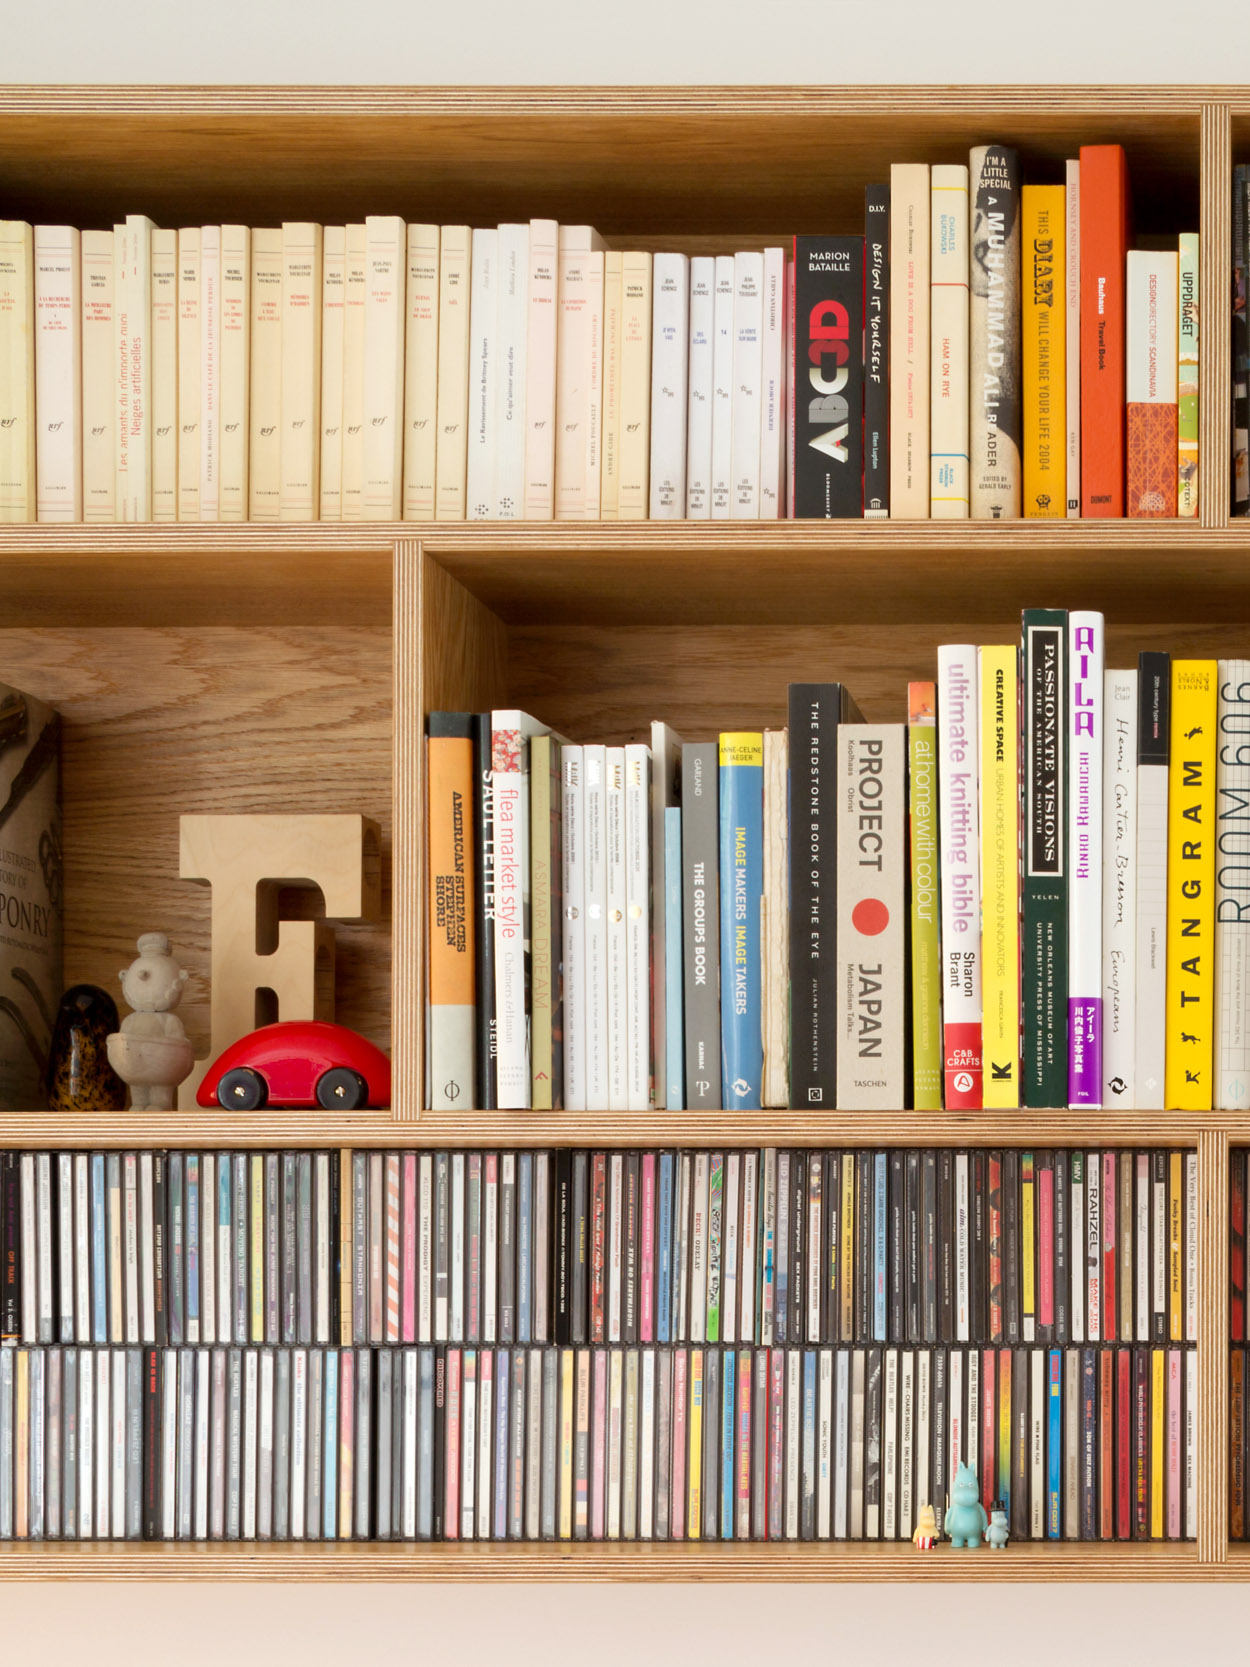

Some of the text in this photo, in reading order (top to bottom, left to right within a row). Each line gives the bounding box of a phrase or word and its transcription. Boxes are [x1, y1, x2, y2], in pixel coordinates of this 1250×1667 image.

[869, 205, 885, 213] D.I.Y.
[980, 179, 1011, 190] SPECIAL
[984, 168, 1008, 178] LITTLE
[809, 252, 850, 260] MARION
[809, 263, 850, 272] BATAILLE
[1182, 272, 1193, 337] UPPDRAGET
[870, 243, 882, 383] DESIGN IT YOURSELF
[983, 197, 1005, 467] A MUHAMMAD ALI READER
[1034, 211, 1053, 470] THIS DIARY WILL CHANGE YOUR LIFE 2004
[131, 337, 144, 436] Neiges artificielles
[859, 739, 882, 871] PROJECT
[947, 663, 973, 932] ultimate knitting bible
[1044, 645, 1055, 861] PASSIONATE VISIONS
[453, 792, 466, 952] AMERICAN SURFACES
[498, 790, 519, 938] flea market style
[1181, 761, 1202, 1007] TANGRAM
[694, 862, 706, 985] THE GROUPS BOOK
[858, 964, 882, 1057] JAPAN
[947, 1057, 980, 1066] CRAFTS
[1048, 1033, 1053, 1044] OF
